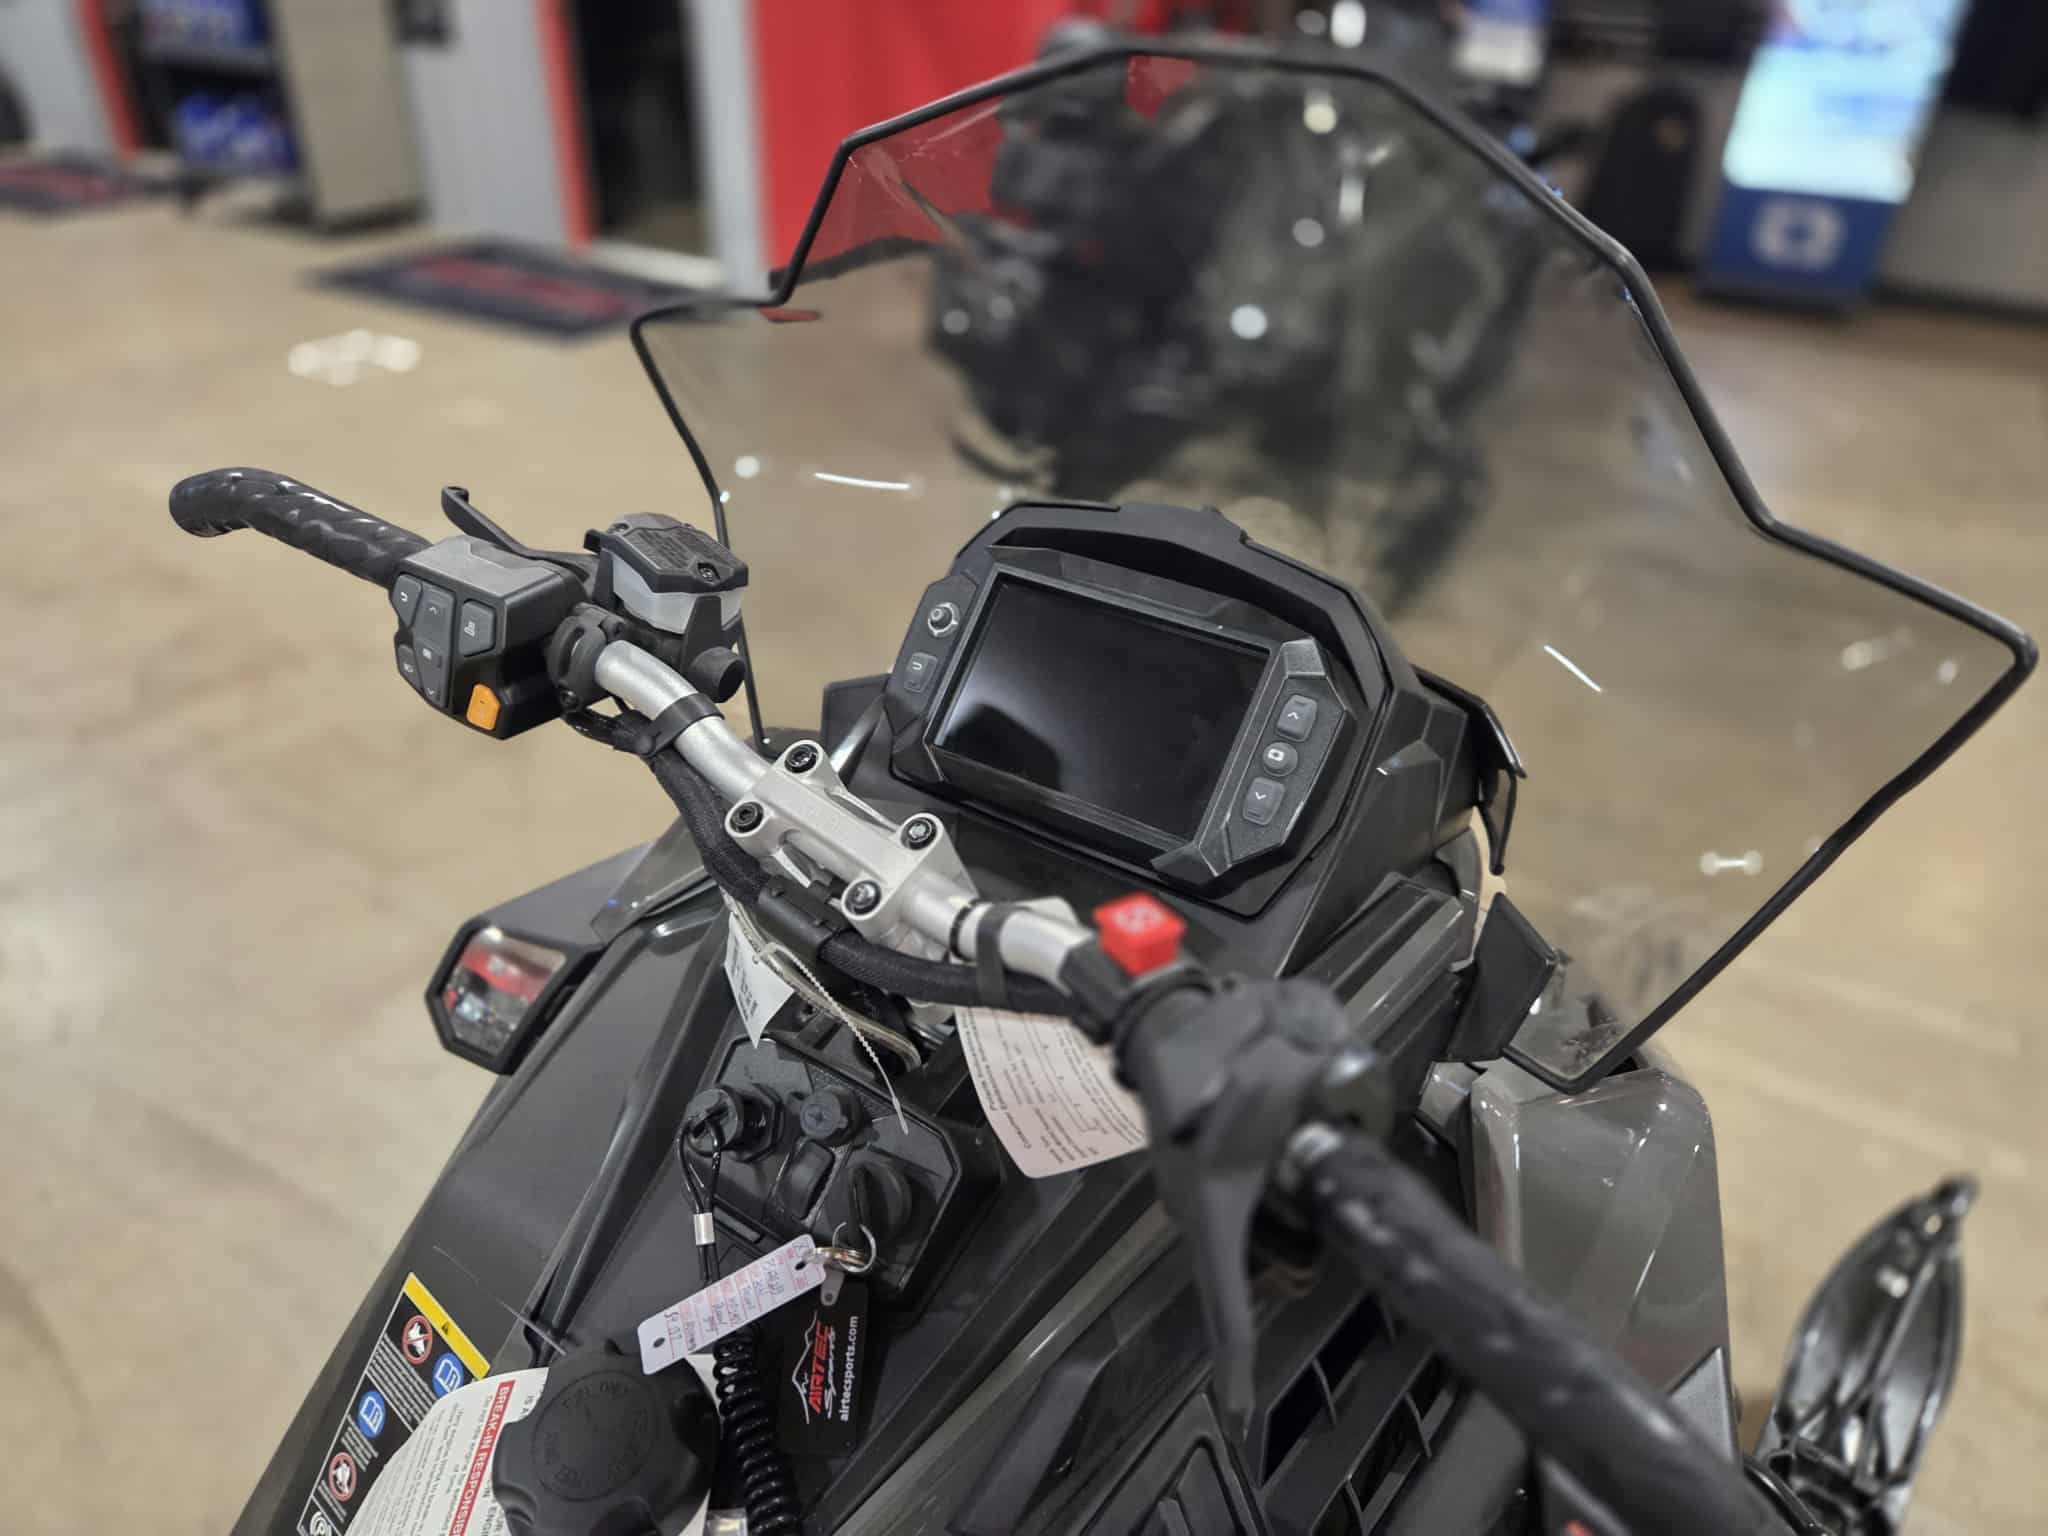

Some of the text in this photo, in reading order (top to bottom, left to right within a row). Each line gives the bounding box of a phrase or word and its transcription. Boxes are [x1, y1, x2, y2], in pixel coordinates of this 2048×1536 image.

[809, 1320, 830, 1414] AIRTEC
[839, 1316, 858, 1422] airtecsports.com
[483, 1386, 509, 1449] BREAK-IN
